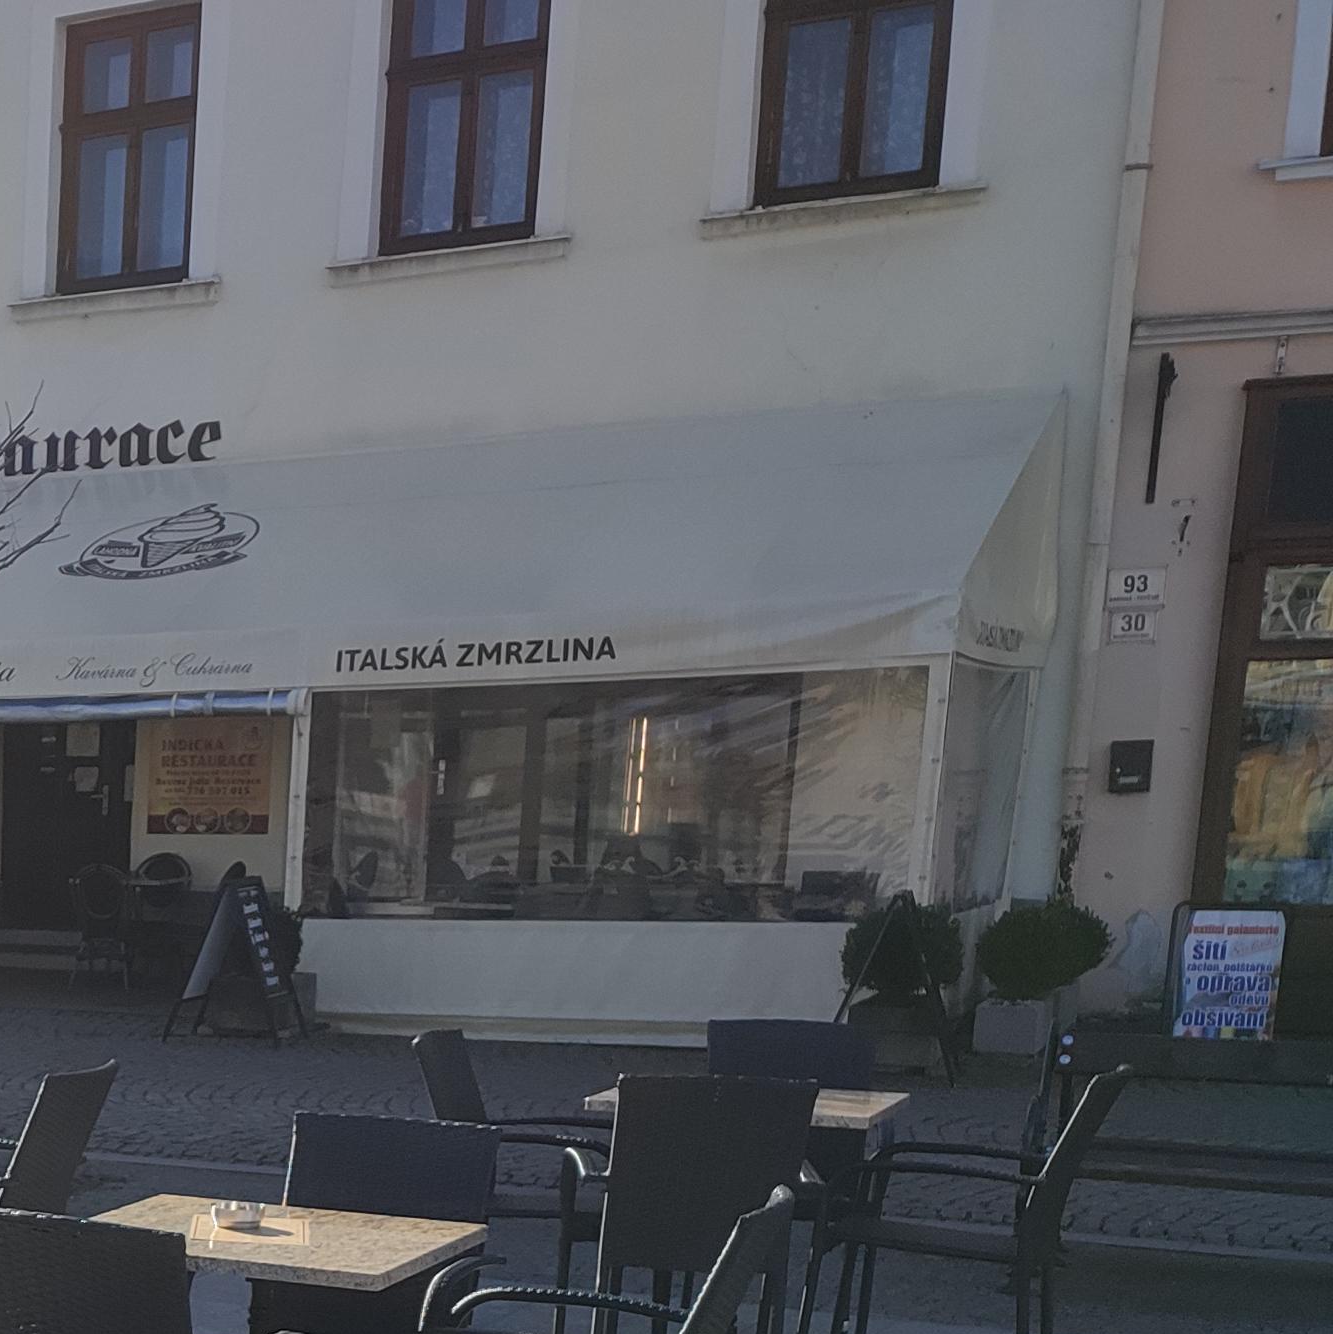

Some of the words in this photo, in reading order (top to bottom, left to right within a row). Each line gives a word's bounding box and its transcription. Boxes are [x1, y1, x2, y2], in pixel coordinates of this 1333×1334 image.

[1124, 574, 1148, 593] 93
[1121, 613, 1145, 632] 30
[336, 638, 447, 672] ITALSKÁ
[455, 636, 617, 666] ZMRZLINA
[55, 656, 137, 681] Kavárna
[139, 657, 166, 688] &
[170, 652, 253, 676] Cukrárna
[1196, 974, 1271, 993] oprava
